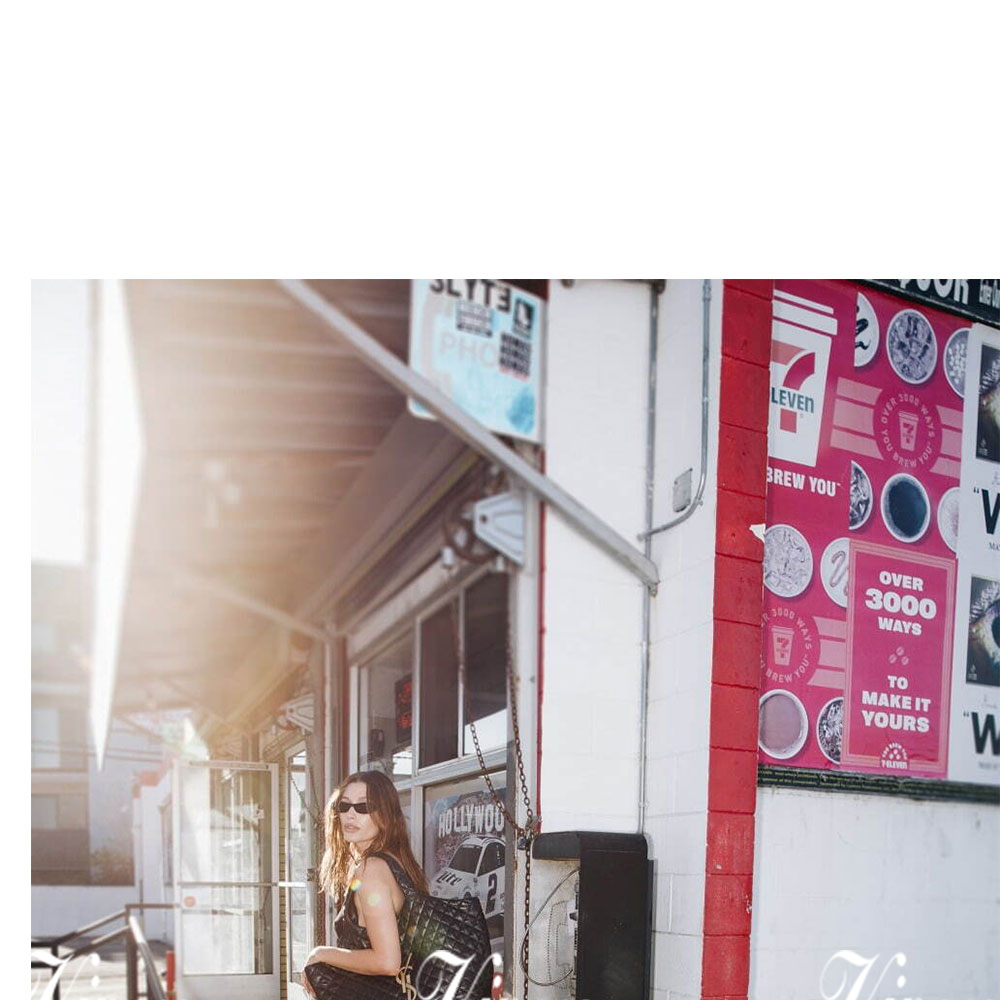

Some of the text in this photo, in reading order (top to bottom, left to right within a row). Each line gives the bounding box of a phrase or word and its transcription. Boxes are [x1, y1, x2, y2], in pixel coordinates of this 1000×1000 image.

[881, 397, 898, 424] OVER
[767, 466, 805, 490] BREW
[879, 570, 924, 592] OVER
[865, 588, 937, 620] 3000
[878, 616, 922, 636] WAYS
[765, 668, 792, 683] BREW
[887, 675, 909, 690] TO
[862, 690, 931, 712] MAKE IT
[861, 710, 930, 733] YOURS
[438, 803, 505, 838] HOLLYWOO
[485, 873, 498, 914] 2
